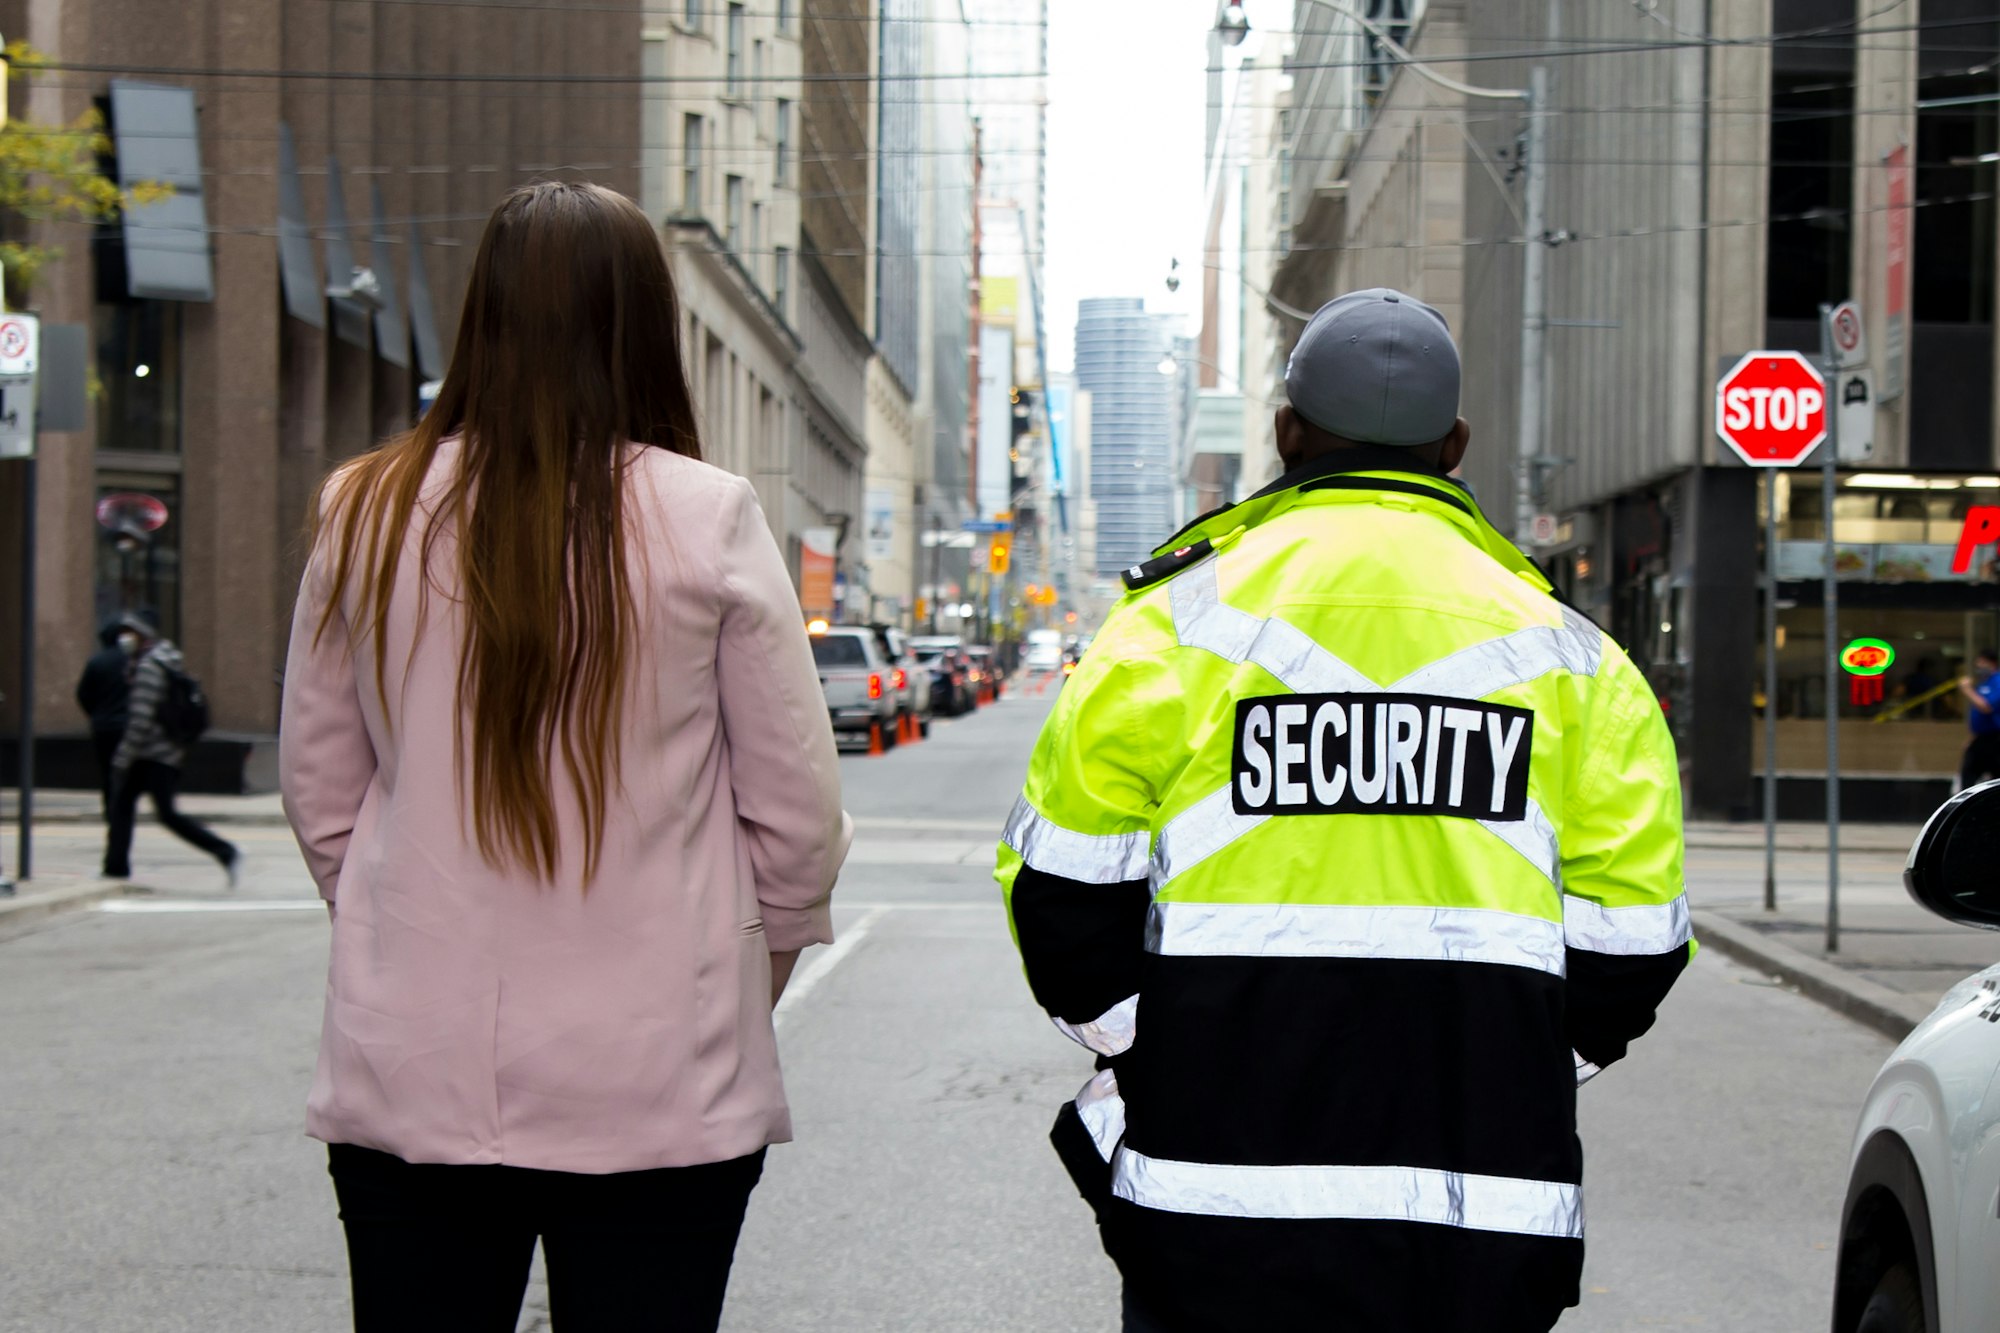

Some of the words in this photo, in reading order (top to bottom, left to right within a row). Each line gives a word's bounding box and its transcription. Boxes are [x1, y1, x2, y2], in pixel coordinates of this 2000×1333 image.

[1725, 387, 1823, 431] STOP
[1952, 505, 2000, 574] P
[1239, 701, 1526, 813] SECURITY
